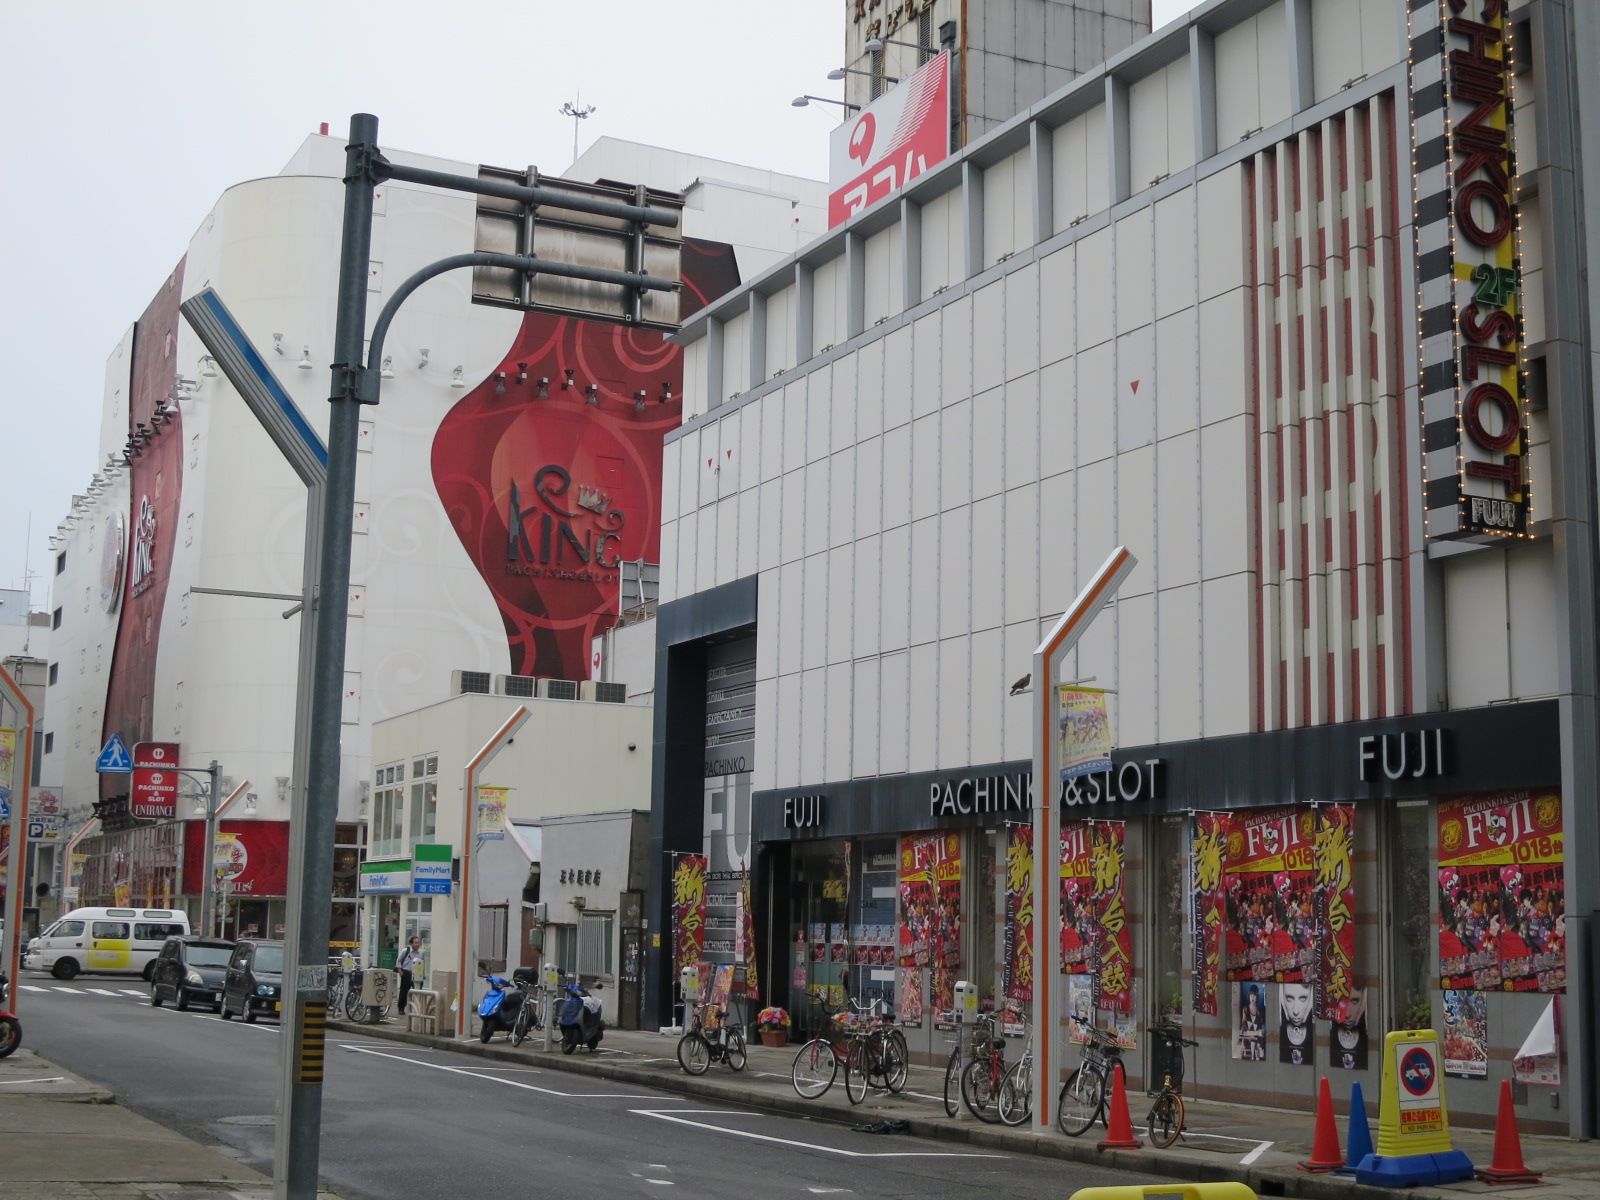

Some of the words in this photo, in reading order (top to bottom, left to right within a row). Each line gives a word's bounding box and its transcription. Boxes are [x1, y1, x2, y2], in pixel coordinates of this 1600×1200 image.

[1470, 263, 1517, 307] 2F
[1459, 303, 1521, 495] SLOT
[507, 466, 624, 569] KING
[1471, 497, 1516, 528] FUJI
[704, 756, 746, 777] PACHINKO
[1360, 728, 1442, 781] FUJI
[135, 804, 175, 817] ENTRANCE
[783, 795, 821, 828] FUJI
[415, 866, 450, 875] FamilyMart
